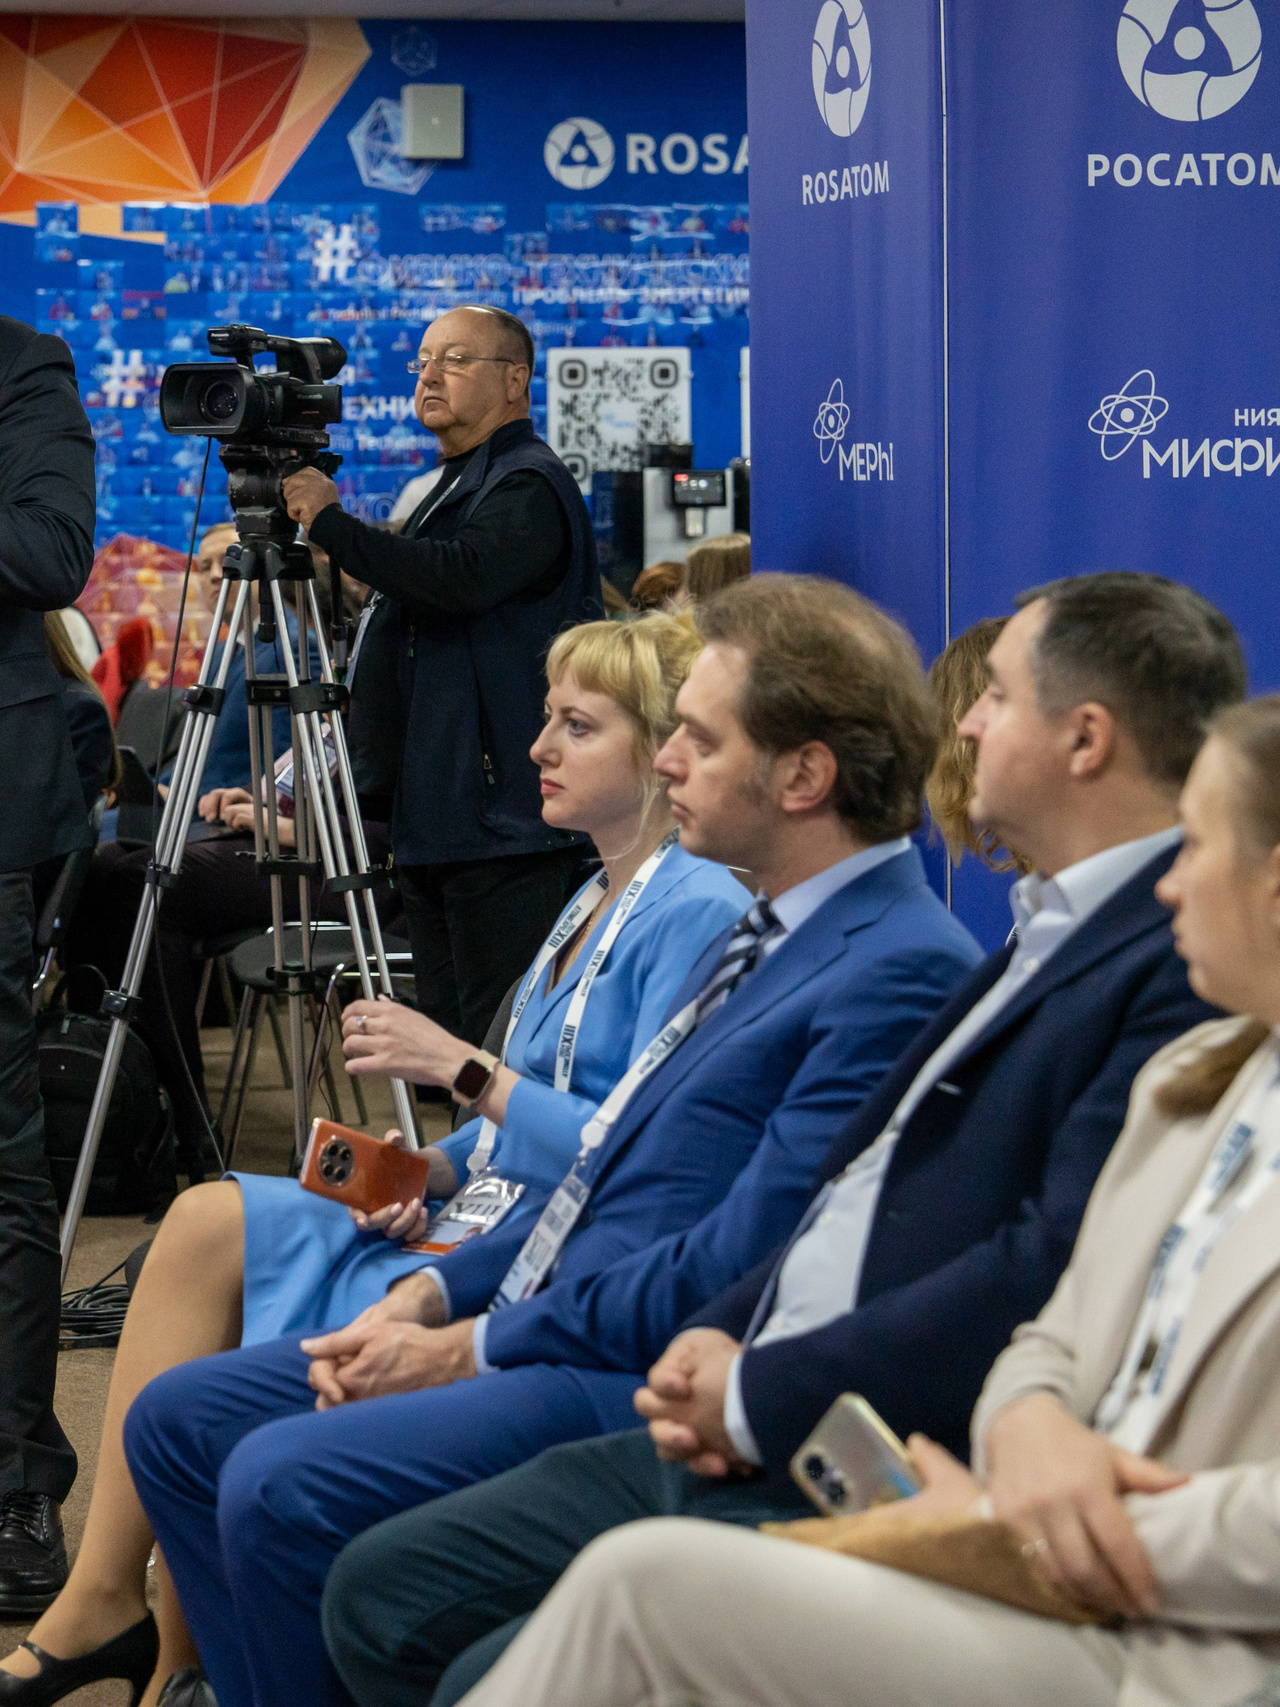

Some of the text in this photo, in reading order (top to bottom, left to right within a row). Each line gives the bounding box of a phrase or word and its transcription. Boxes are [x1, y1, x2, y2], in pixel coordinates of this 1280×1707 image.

[802, 160, 890, 206] ROSATOM
[838, 442, 894, 482] MEPhI
[560, 905, 581, 929] ATOMEXPO
[548, 928, 567, 948] XIII
[561, 1024, 575, 1045] XIII
